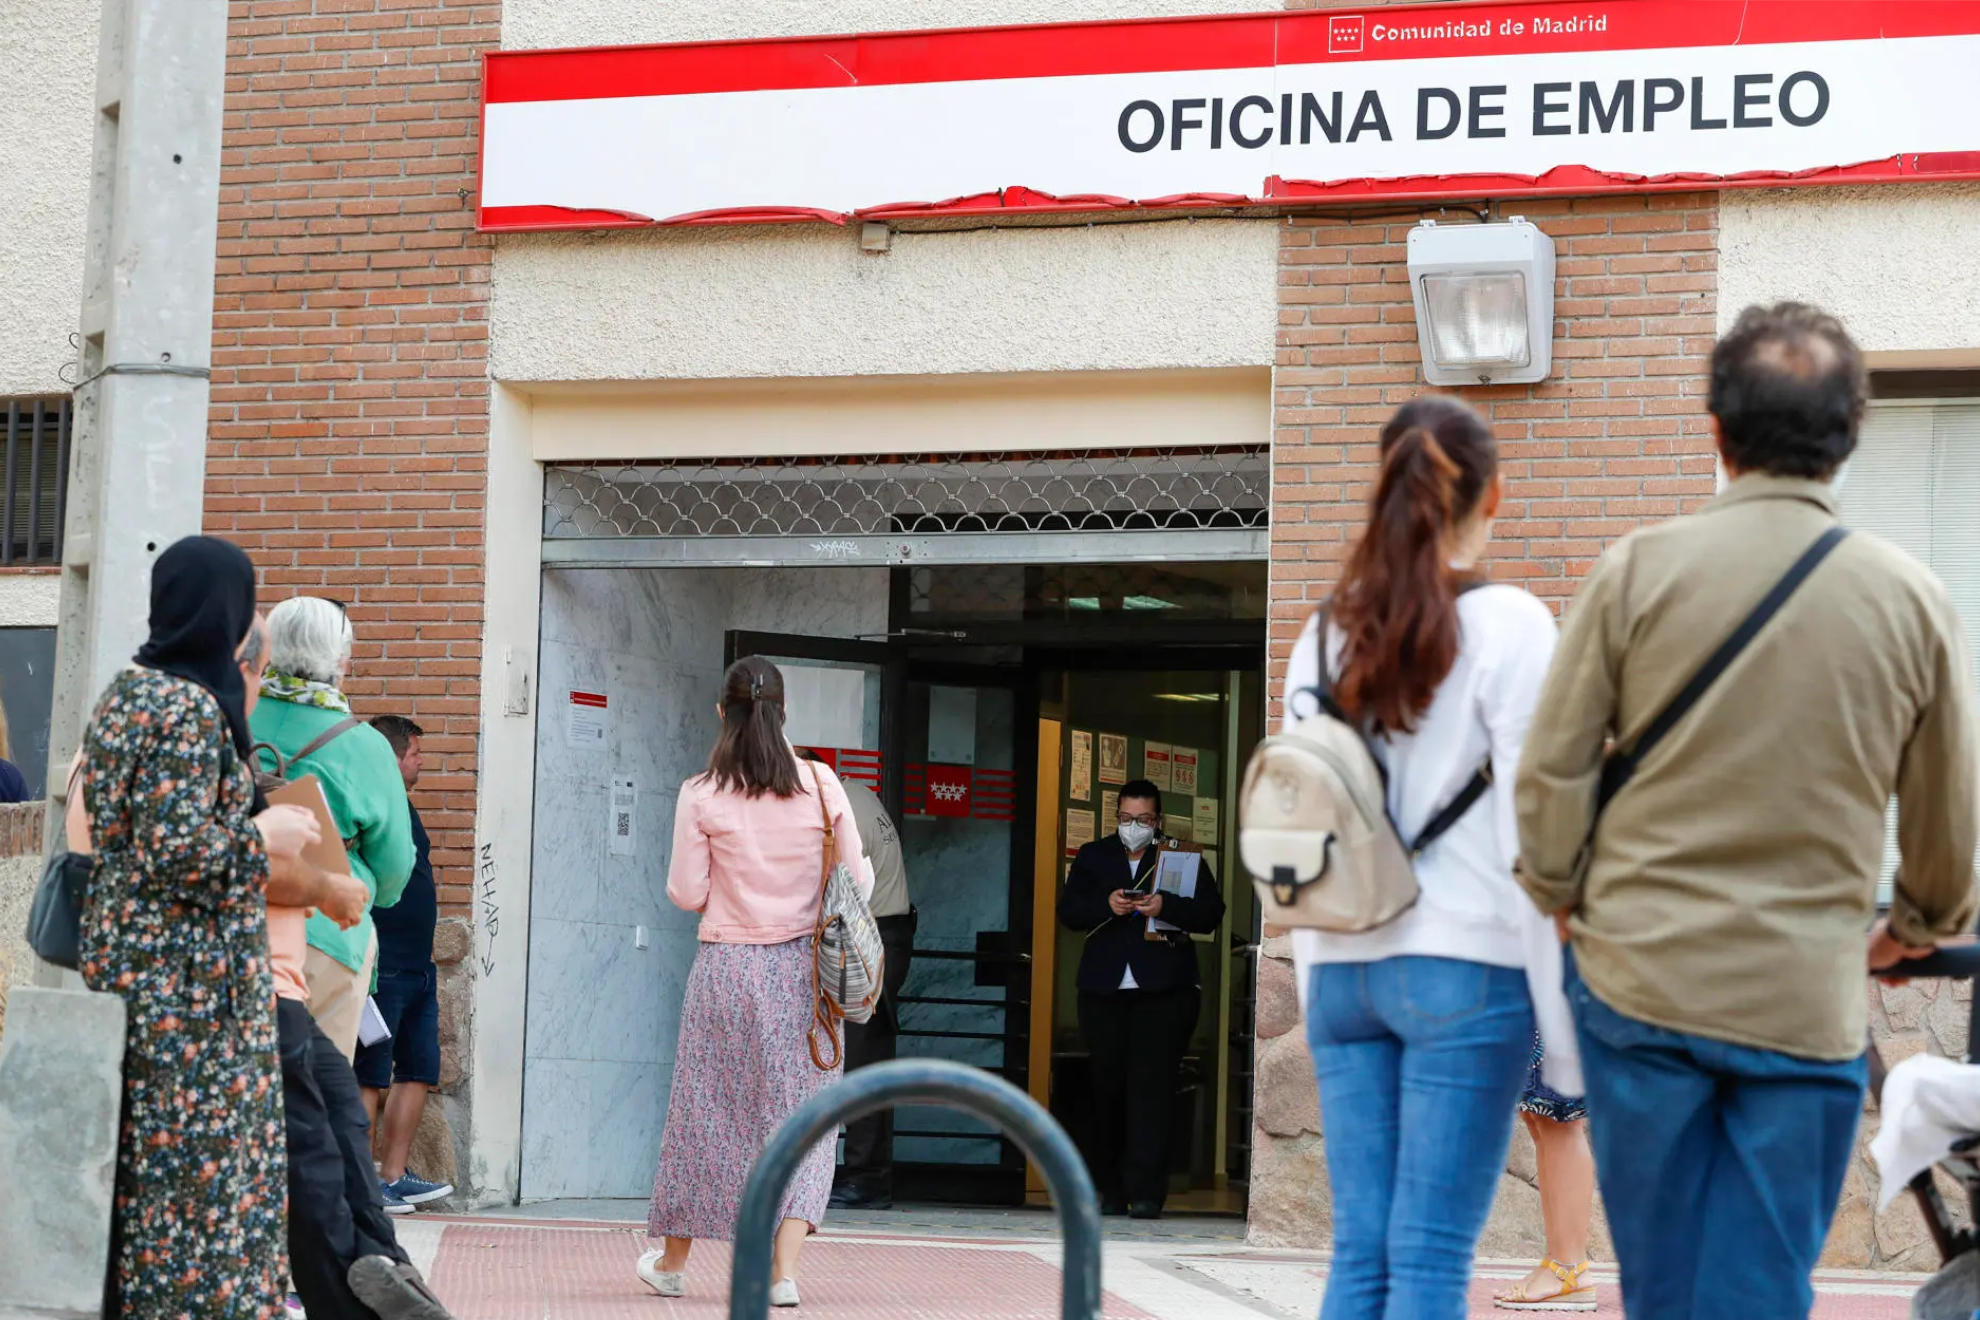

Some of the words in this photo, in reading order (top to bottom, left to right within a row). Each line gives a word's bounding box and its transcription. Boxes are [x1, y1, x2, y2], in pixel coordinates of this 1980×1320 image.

[1371, 19, 1491, 41] Comunidad
[1499, 18, 1525, 36] de
[1533, 14, 1607, 34] Madrid
[1117, 90, 1393, 152] OFICINA
[1416, 85, 1507, 140] DE
[1532, 71, 1830, 136] EMPLEO
